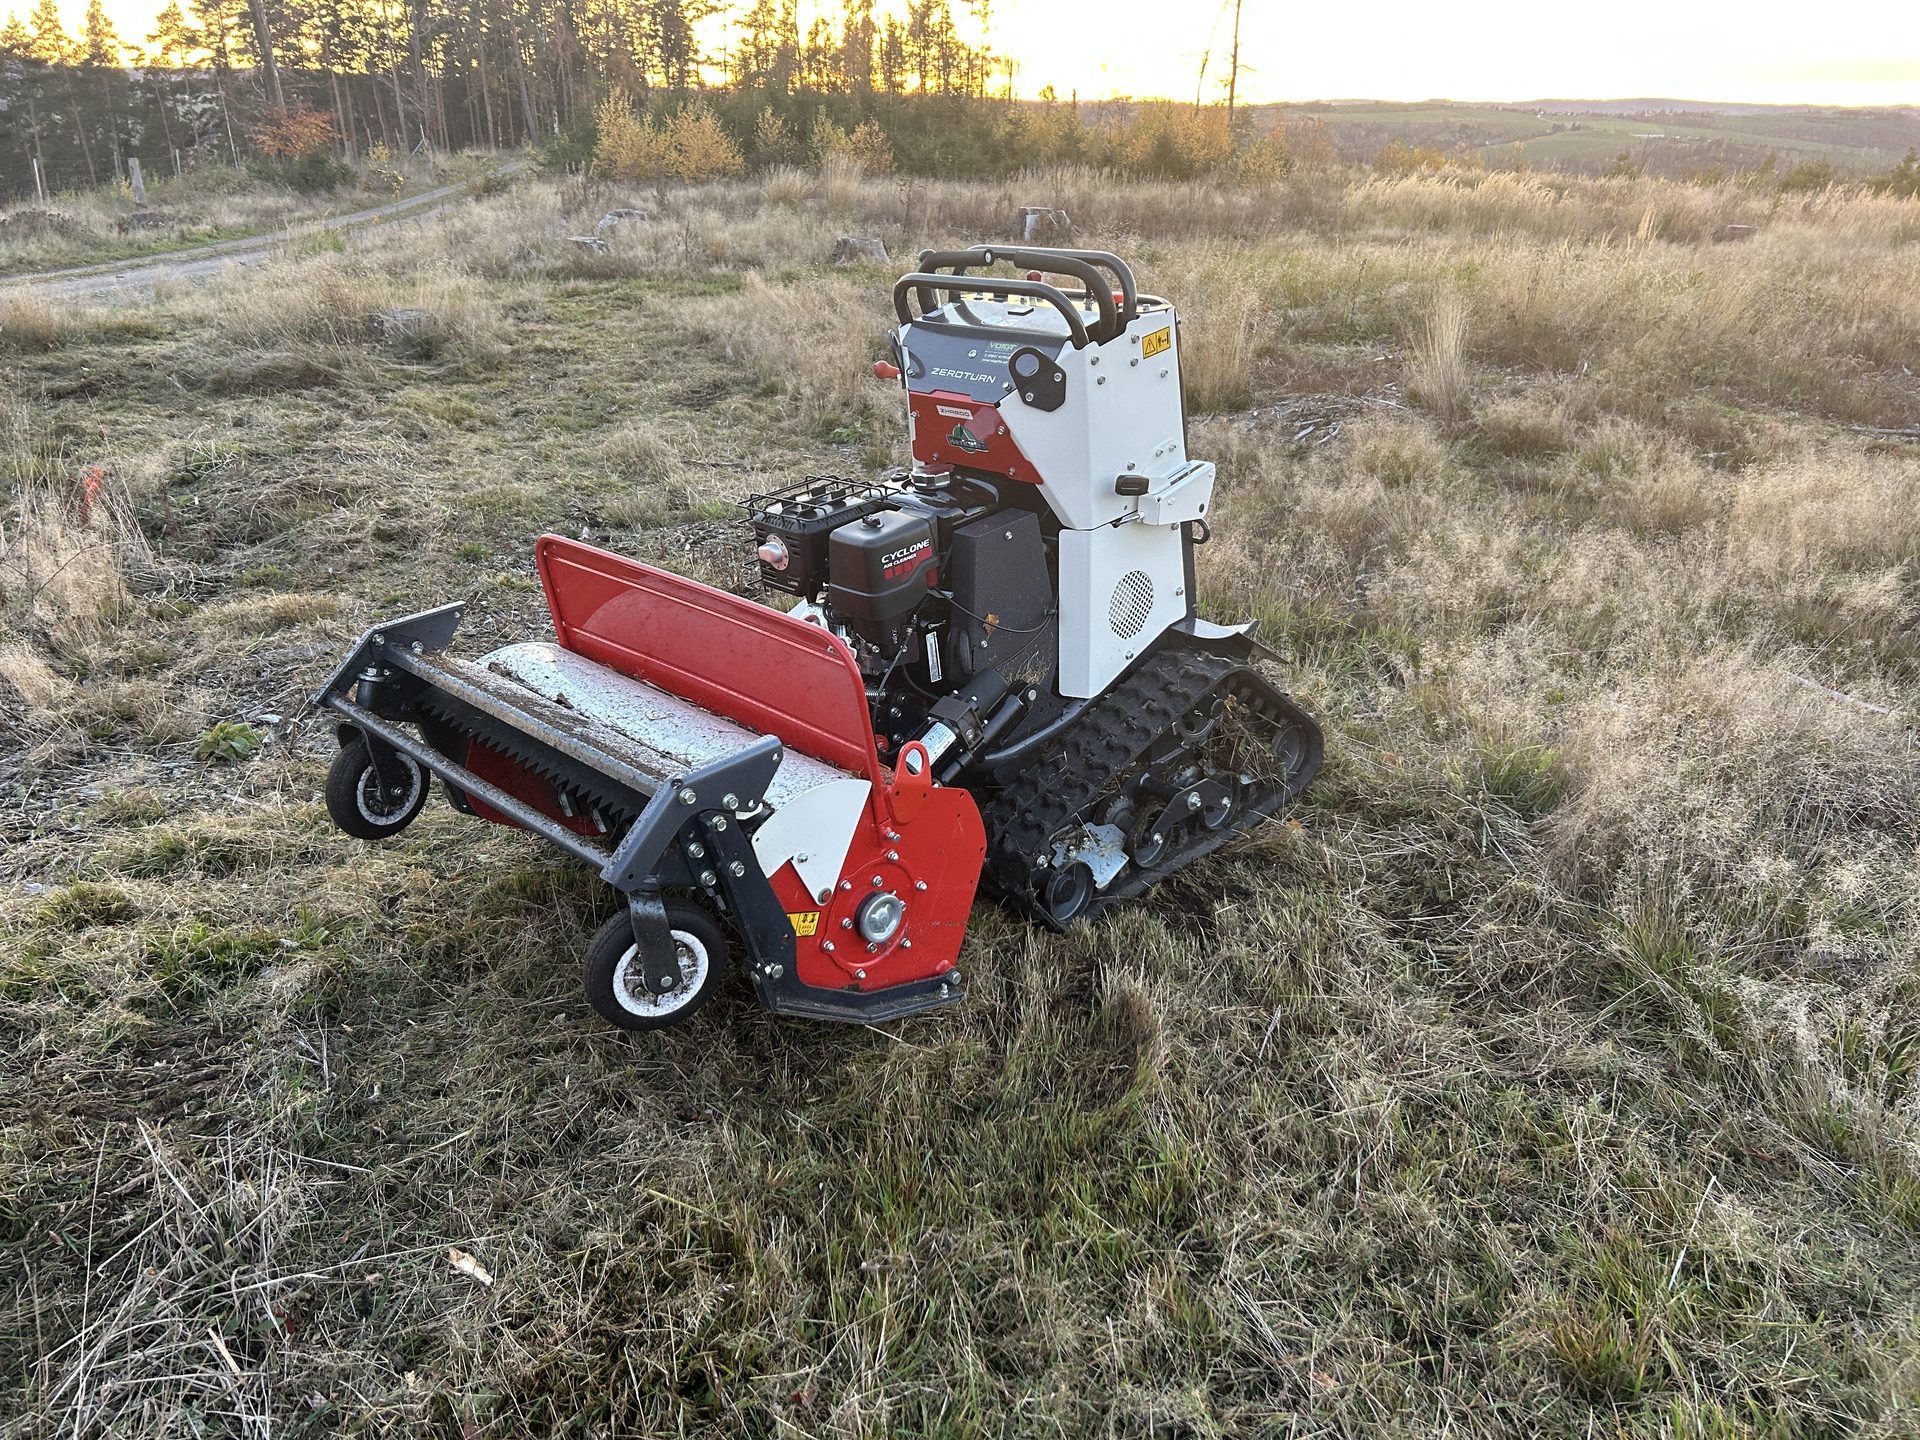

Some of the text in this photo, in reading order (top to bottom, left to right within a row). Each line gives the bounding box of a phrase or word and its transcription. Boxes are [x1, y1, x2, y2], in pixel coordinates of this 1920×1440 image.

[990, 342, 1017, 350] VOIGT
[931, 367, 996, 384] ZEROTURN
[881, 538, 930, 563] CYCLONE
